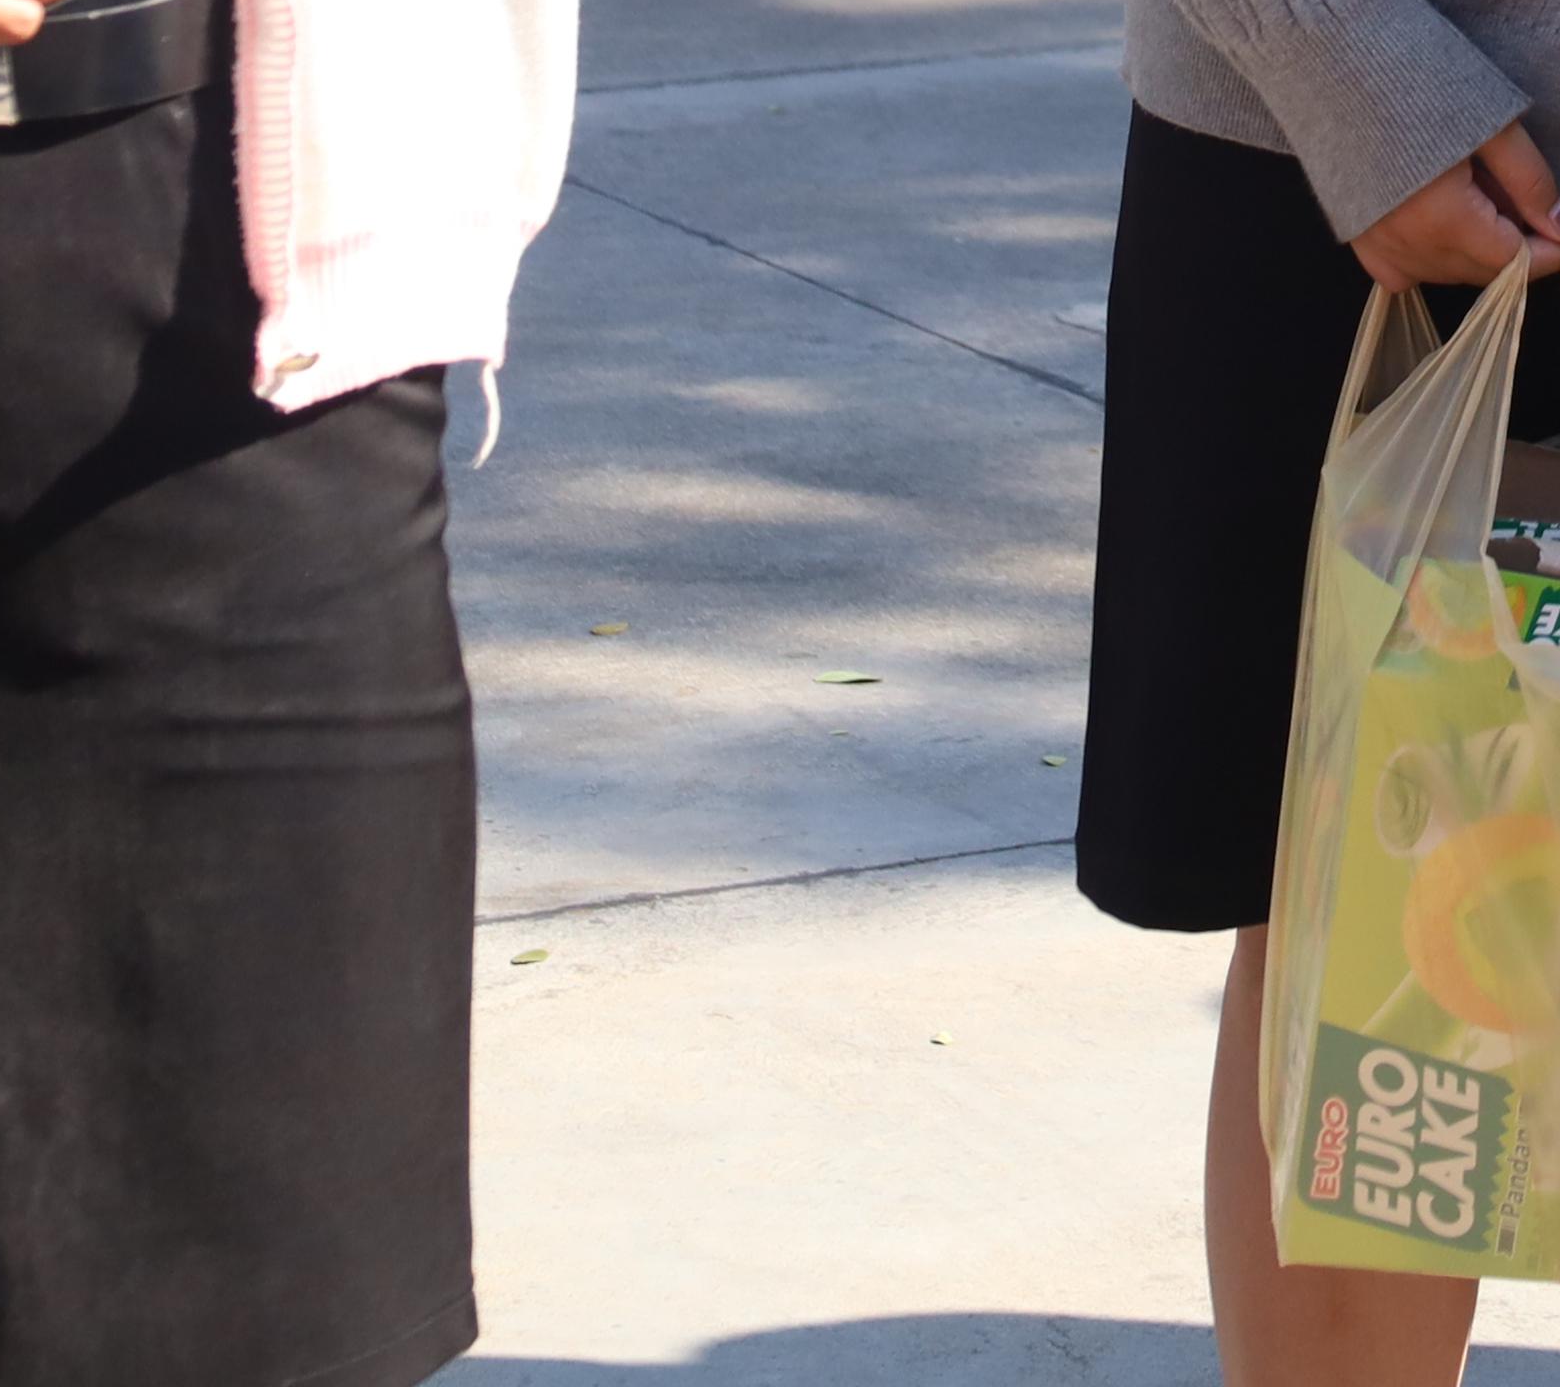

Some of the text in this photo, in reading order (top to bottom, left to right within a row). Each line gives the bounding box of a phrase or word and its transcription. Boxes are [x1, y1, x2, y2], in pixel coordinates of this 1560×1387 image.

[1309, 1096, 1350, 1201] EURO
[1353, 1047, 1419, 1228] EURO
[1415, 1064, 1481, 1239] CAKE
